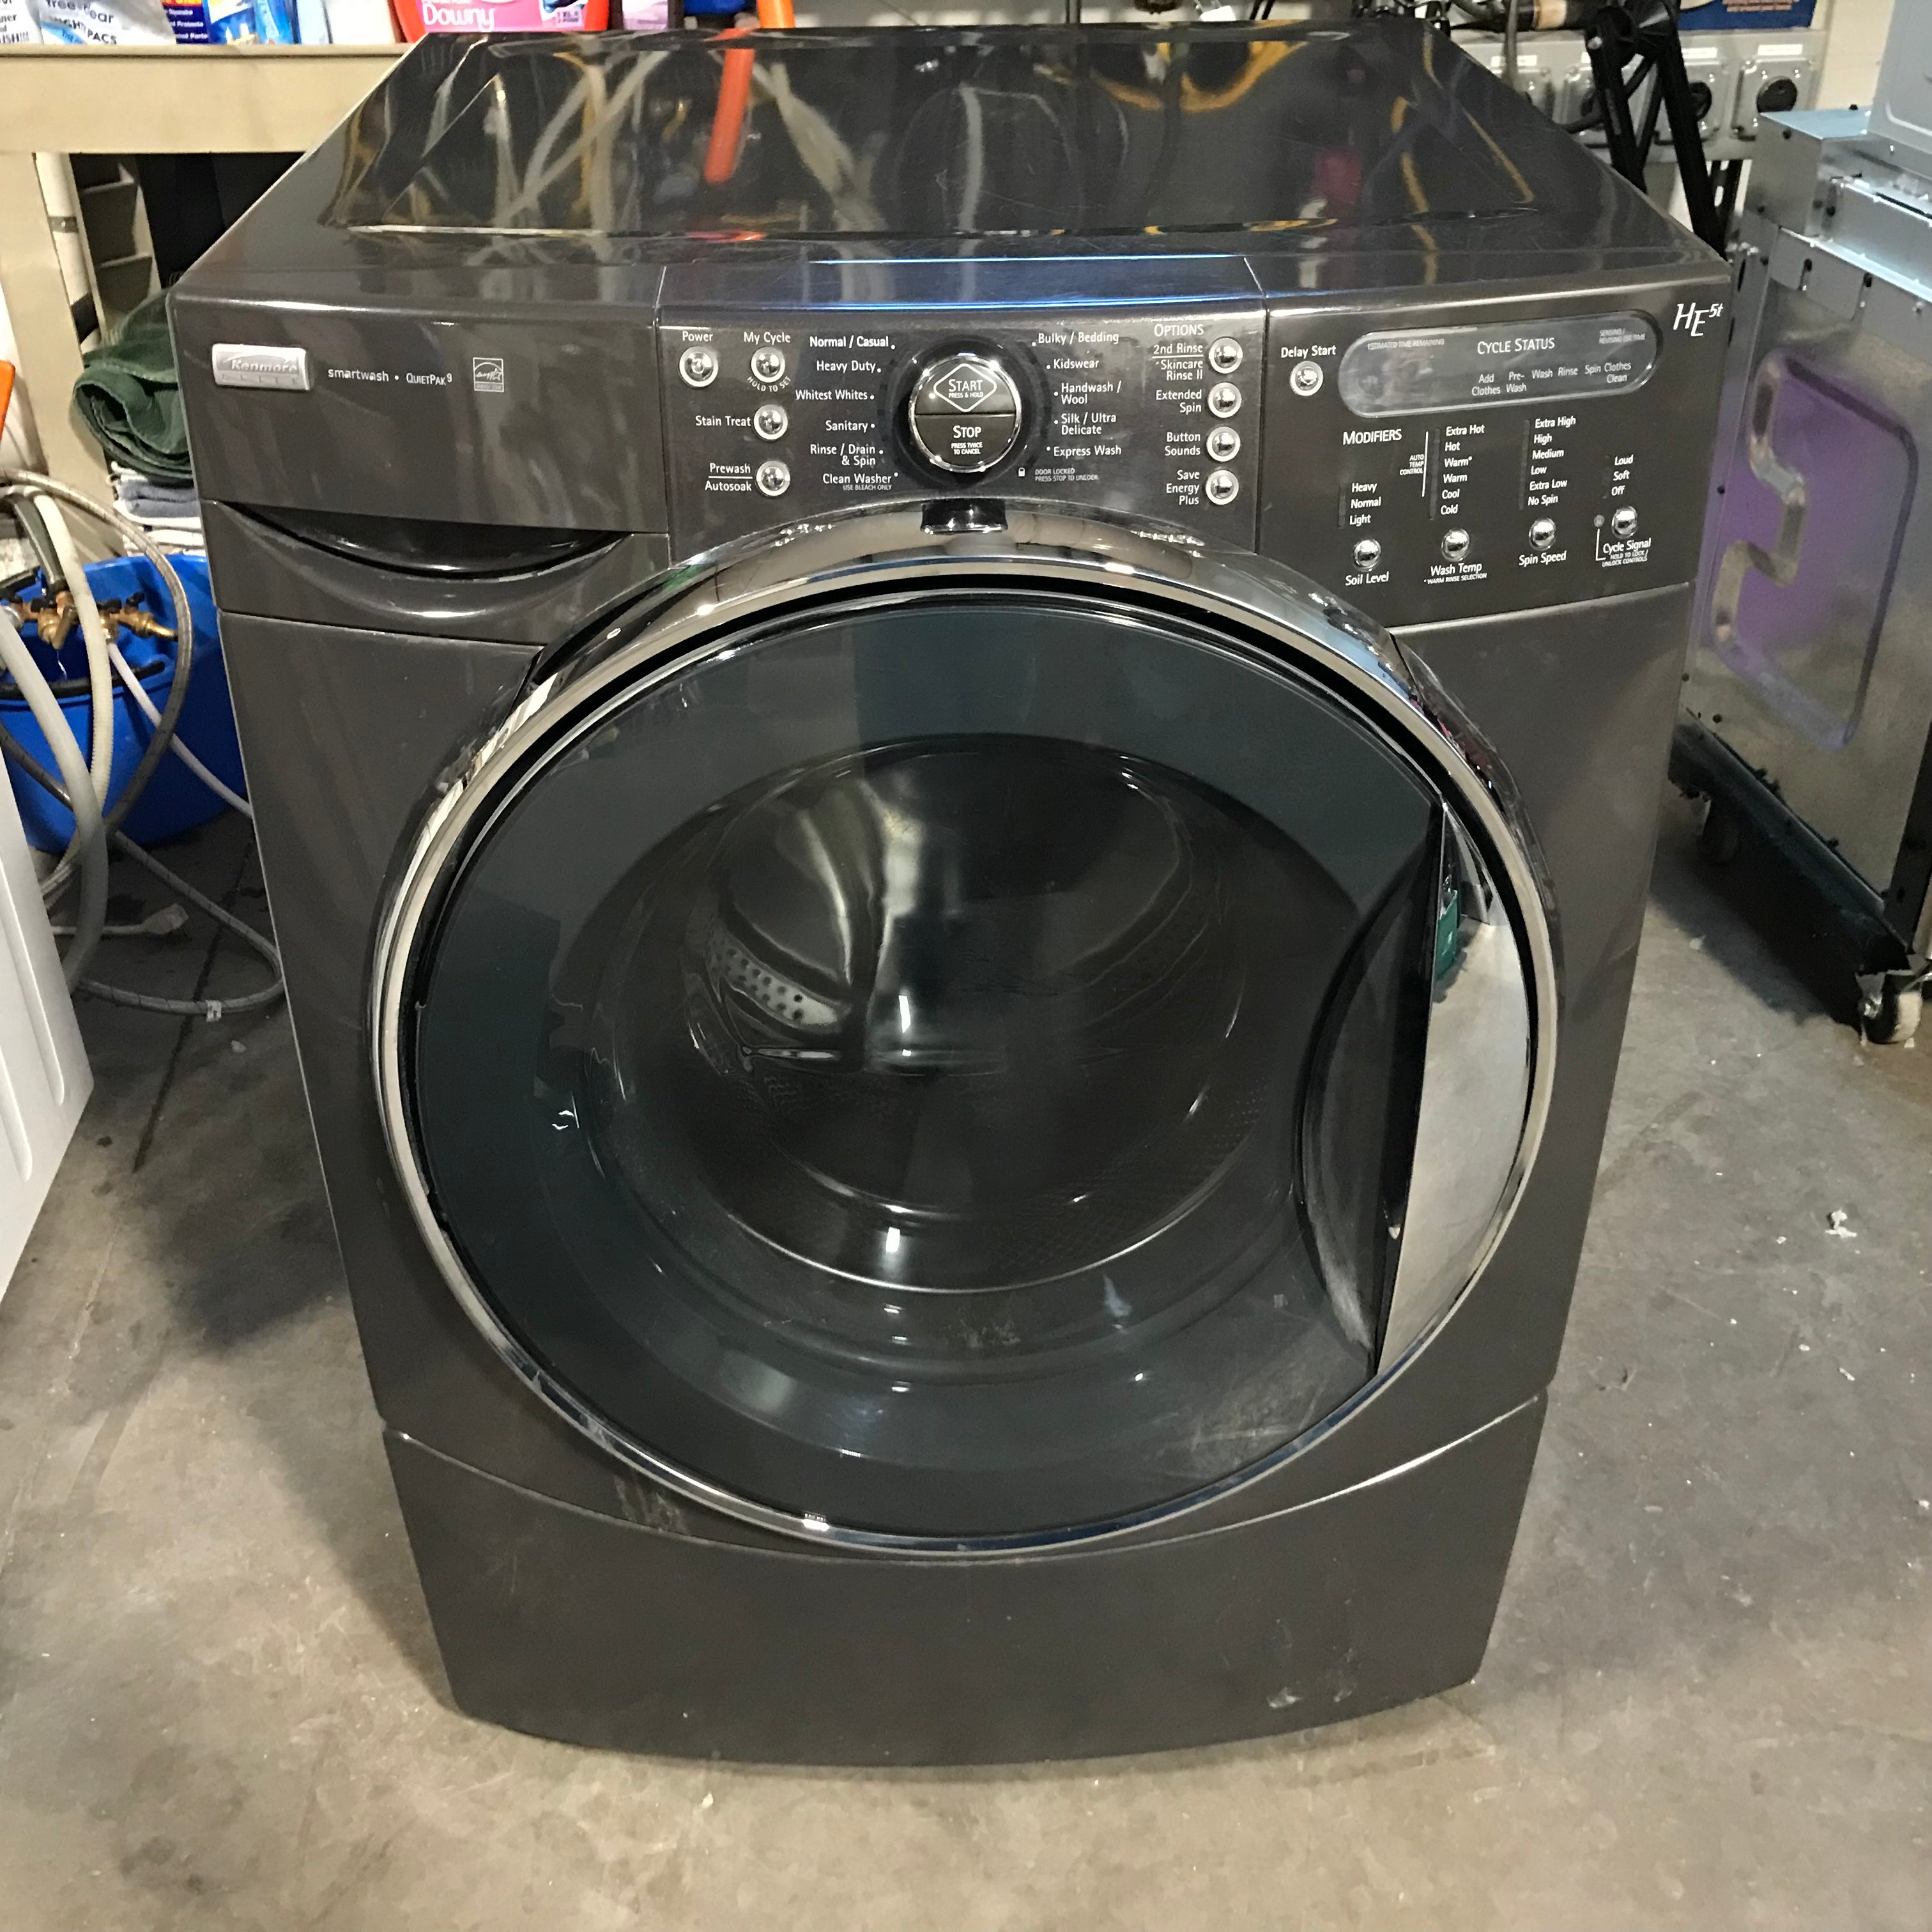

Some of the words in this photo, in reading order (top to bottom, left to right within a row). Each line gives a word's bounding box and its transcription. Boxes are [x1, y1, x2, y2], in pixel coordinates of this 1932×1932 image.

[422, 4, 495, 32] Downy
[88, 28, 117, 44] PACS
[1154, 323, 1204, 337] OPTIONS
[682, 331, 713, 342] Power
[744, 332, 760, 345] My
[763, 332, 791, 344] Cycle
[809, 335, 847, 347] Normal
[849, 335, 854, 348] /
[856, 336, 889, 347] Casual
[1038, 332, 1066, 345] Bulky
[1069, 332, 1075, 345] /
[1078, 332, 1119, 345] Bedding
[1153, 344, 1173, 354] 2nd
[1176, 343, 1204, 353] Rinse
[1281, 348, 1308, 359] Delay
[1312, 345, 1337, 356] Start
[1477, 341, 1512, 355] CYCLE
[1515, 337, 1555, 352] STATUS
[231, 358, 298, 372] Kenmore
[816, 361, 847, 373] Heavy
[851, 360, 876, 374] Duty
[1054, 358, 1100, 369] Kidswear
[1160, 360, 1204, 370] Skincare
[1585, 364, 1601, 375] Spin
[1604, 362, 1632, 372] Clothes
[328, 369, 389, 382] smartwash
[1167, 371, 1193, 381] Rinse
[1196, 370, 1203, 379] II
[1508, 372, 1525, 381] Pre-
[1532, 369, 1553, 379] Wash
[1558, 367, 1579, 376] Rinse
[747, 376, 766, 392] HOLD
[779, 376, 791, 389] SET
[1478, 374, 1494, 383] Add
[1607, 374, 1627, 383] Clean
[948, 378, 983, 392] START
[1061, 382, 1114, 394] Handwash
[1116, 381, 1122, 394] /
[1471, 386, 1501, 396] Clothes
[1506, 383, 1527, 393] Wash
[795, 390, 832, 401] Whitest
[835, 390, 868, 401] Whites
[1061, 394, 1087, 404] Wool
[1156, 390, 1202, 401] Extended
[1179, 402, 1202, 415] Spin
[695, 416, 722, 426] Stain
[725, 416, 751, 426] Treat
[1061, 413, 1080, 424] Silk
[1083, 412, 1088, 425] /
[1091, 413, 1117, 424] Ultra
[1535, 418, 1555, 428] Extra
[1557, 415, 1576, 427] High
[825, 420, 868, 433] Sanitary
[953, 425, 982, 438] STOP
[1061, 424, 1102, 436] Delicate
[1446, 426, 1467, 436] Extra
[1469, 424, 1485, 434] Hot
[1167, 432, 1200, 443] Button
[1343, 429, 1402, 445] MODIFIERS
[1533, 433, 1552, 446] High
[810, 444, 837, 454] Rinse
[840, 443, 845, 456] /
[848, 443, 875, 454] Drain
[1054, 446, 1091, 459] Express
[1094, 445, 1122, 457] Wash
[1165, 446, 1200, 456] Sounds
[1445, 441, 1460, 452] Hot
[1532, 448, 1564, 460] Medium
[1614, 454, 1634, 466] Loud
[841, 456, 850, 466] &
[854, 455, 876, 468] Spin
[710, 463, 751, 473] Prewash
[1531, 465, 1547, 475] Low
[823, 473, 850, 484] Clean
[854, 474, 892, 484] Washer
[1177, 470, 1200, 480] Save
[1443, 474, 1468, 483] Warm
[1613, 470, 1630, 481] Soft
[705, 480, 752, 491] Autosoak
[1166, 484, 1200, 496] Energy
[1351, 482, 1377, 493] Heavy
[1529, 480, 1550, 491] Extra
[1551, 479, 1567, 489] Low
[1611, 486, 1625, 496] Off
[1179, 495, 1199, 505] Plus
[1442, 489, 1460, 500] Cool
[1528, 496, 1539, 506] No
[1541, 494, 1558, 506] Spin
[1351, 497, 1381, 509] Normal
[1441, 504, 1459, 515] Cold
[1349, 514, 1371, 526] Light
[1603, 542, 1625, 555] Cycle
[1627, 537, 1652, 551] Signal
[1519, 554, 1538, 567] Spin
[1540, 551, 1567, 565] Speed
[1602, 559, 1621, 567] UNLOCK
[1430, 564, 1455, 576] Wash
[1458, 563, 1482, 574] Temp
[1345, 574, 1363, 586] Soil
[1366, 571, 1390, 583] Level
